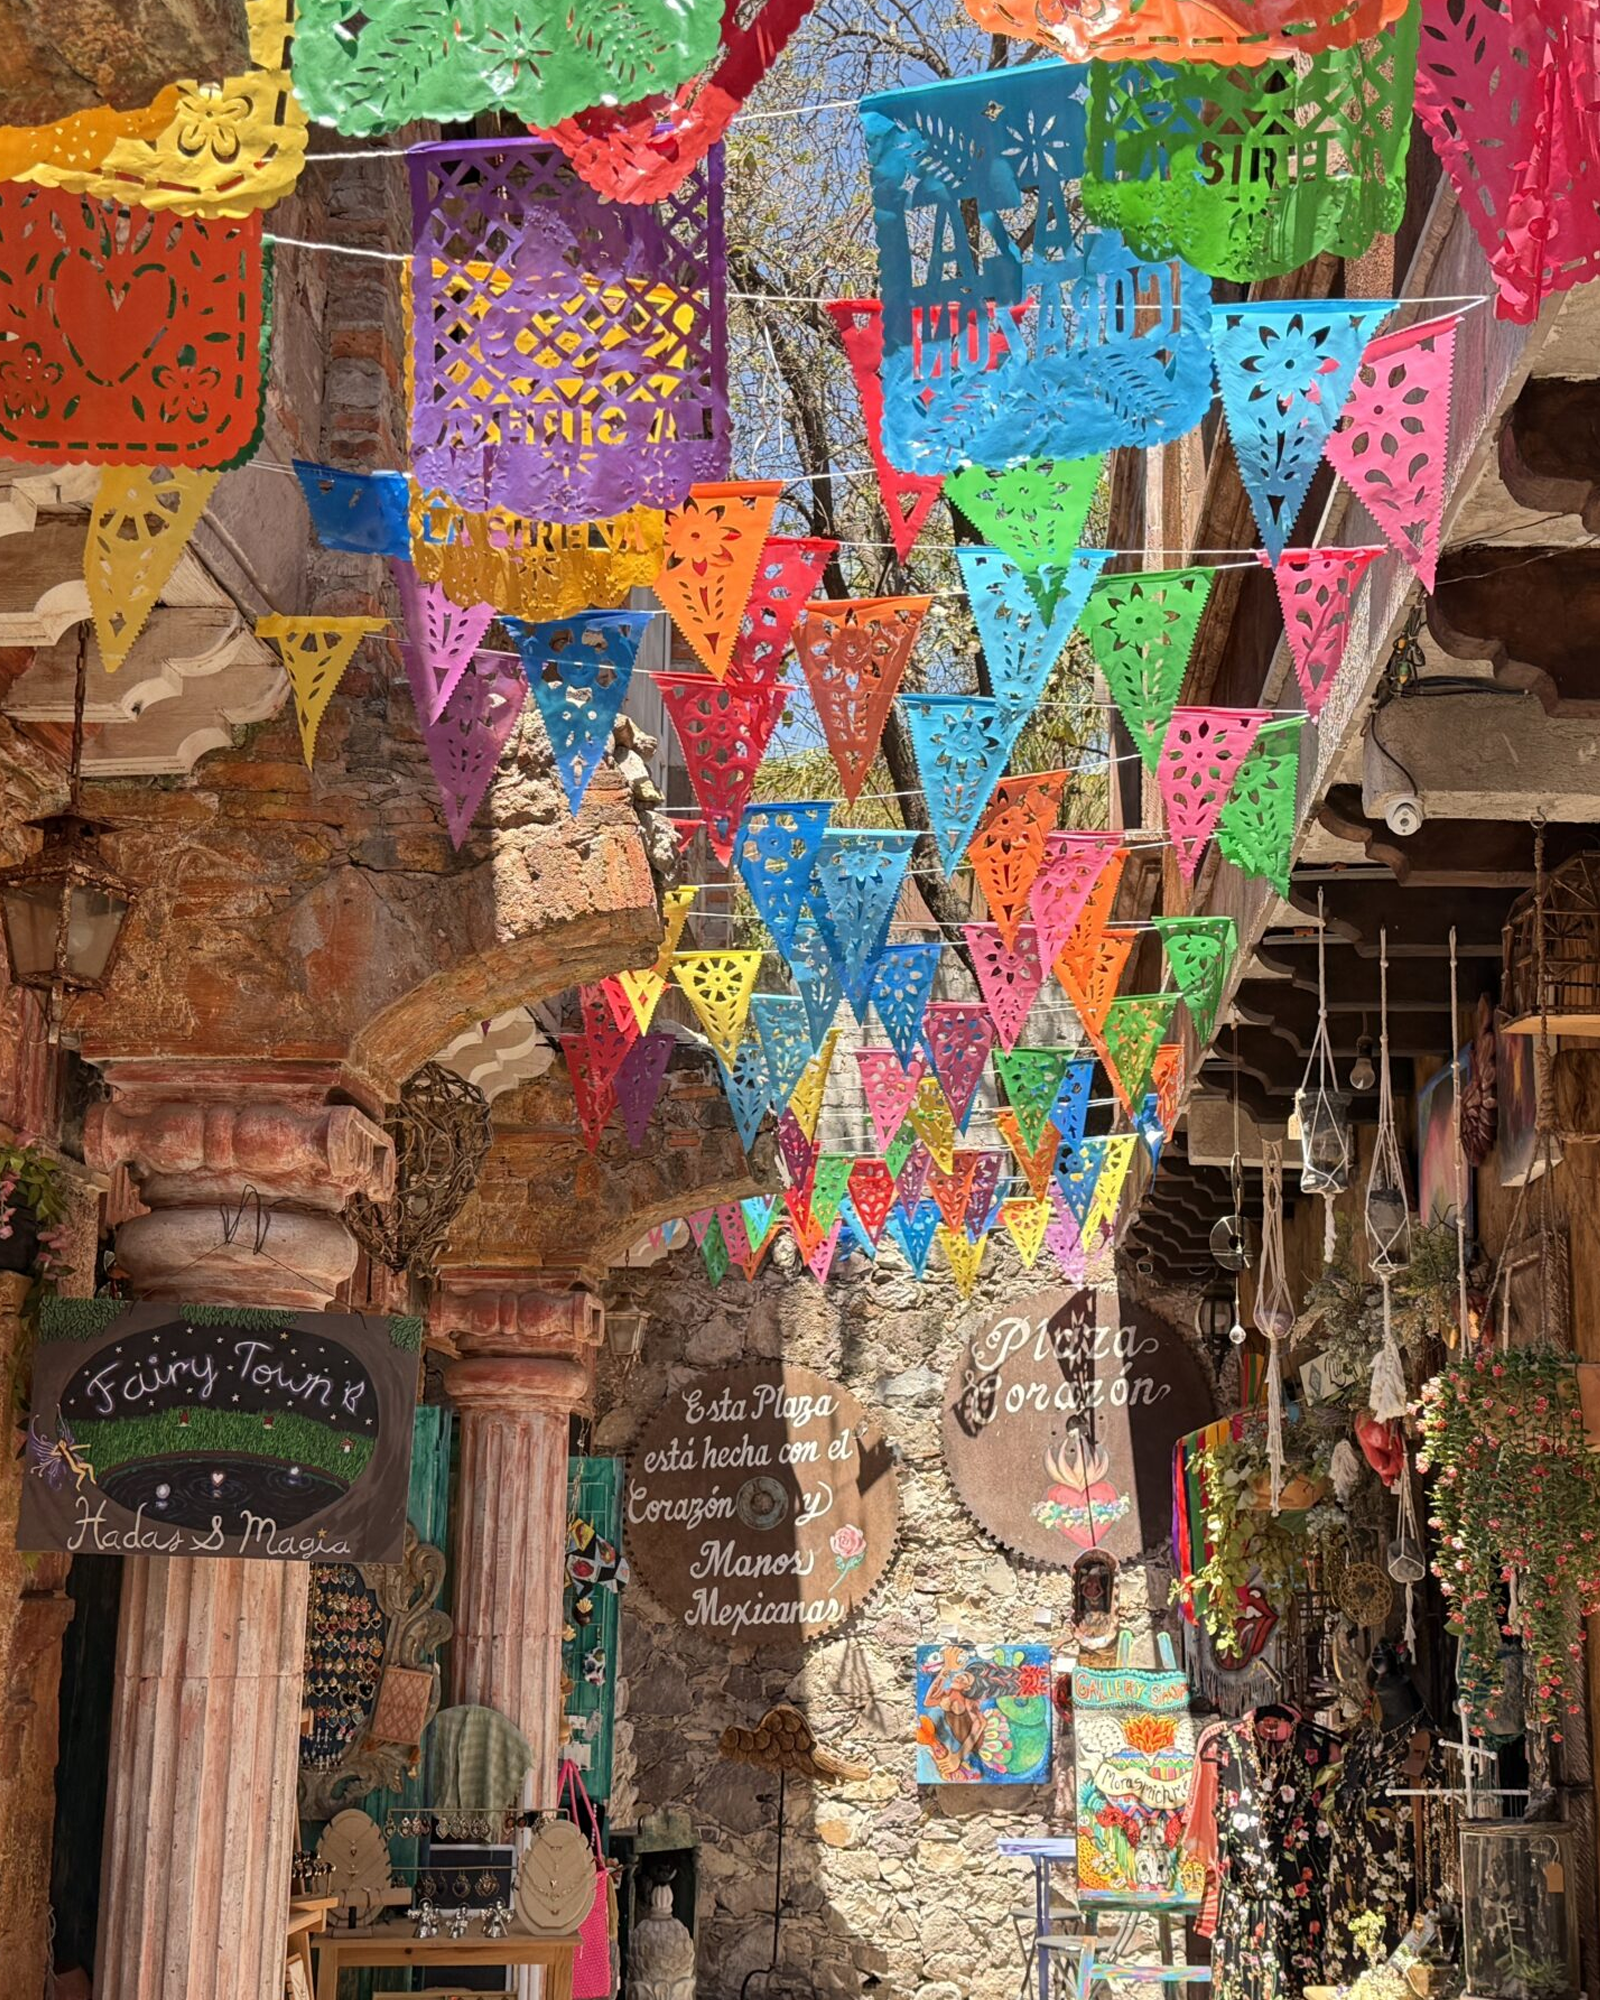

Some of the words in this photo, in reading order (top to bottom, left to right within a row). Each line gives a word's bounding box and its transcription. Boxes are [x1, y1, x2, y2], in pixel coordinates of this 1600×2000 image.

[971, 1315, 1160, 1371] Plaza
[86, 1354, 219, 1415] Fairy
[234, 1340, 333, 1406] Town
[962, 1362, 1171, 1425] Corazón
[682, 1387, 747, 1424] Esta
[750, 1384, 839, 1427] Plaza
[644, 1436, 698, 1473] está
[702, 1434, 772, 1470] hecha
[778, 1442, 821, 1465] con
[827, 1430, 854, 1461] el
[66, 1496, 185, 1552] Hadas
[239, 1509, 351, 1559] Magia
[628, 1478, 737, 1530] Corazón
[794, 1480, 834, 1527] y
[690, 1540, 815, 1579] Manos
[684, 1587, 845, 1635] Mexicanas
[1076, 1673, 1147, 1701] GALLERY
